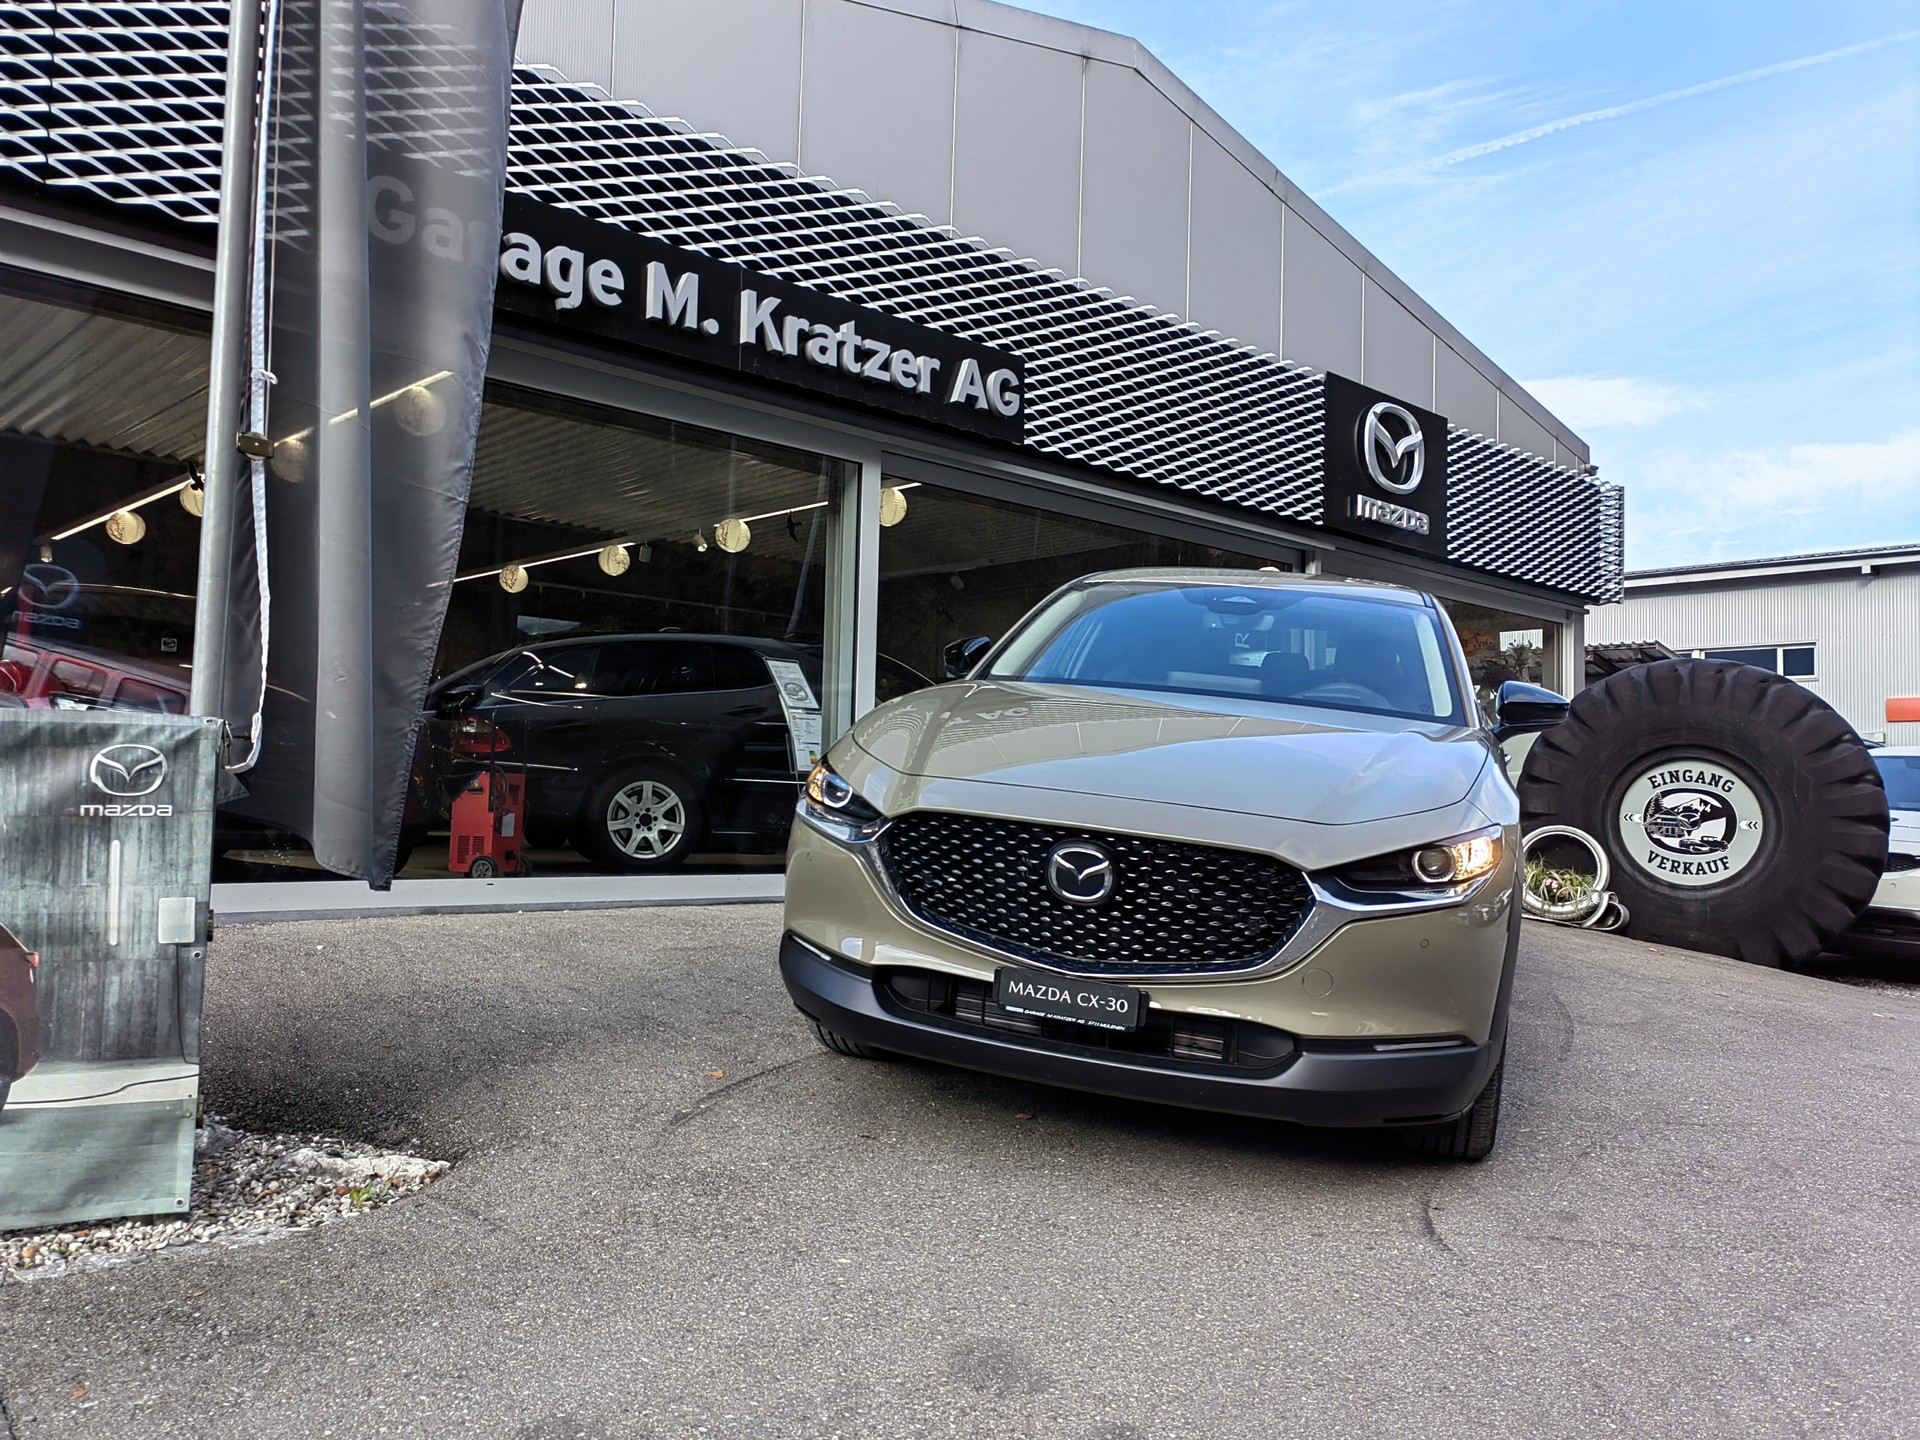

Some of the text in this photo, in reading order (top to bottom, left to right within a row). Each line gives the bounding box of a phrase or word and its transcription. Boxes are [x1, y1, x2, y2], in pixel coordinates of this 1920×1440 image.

[645, 260, 720, 337] M.
[739, 288, 941, 395] Kratzer
[949, 357, 1021, 417] AG
[1356, 493, 1431, 536] mazda
[1647, 769, 1736, 793] EINGANG
[79, 804, 173, 817] mazda
[1647, 850, 1730, 875] VERKAUF
[1008, 980, 1129, 1013] MAZDA CX-30
